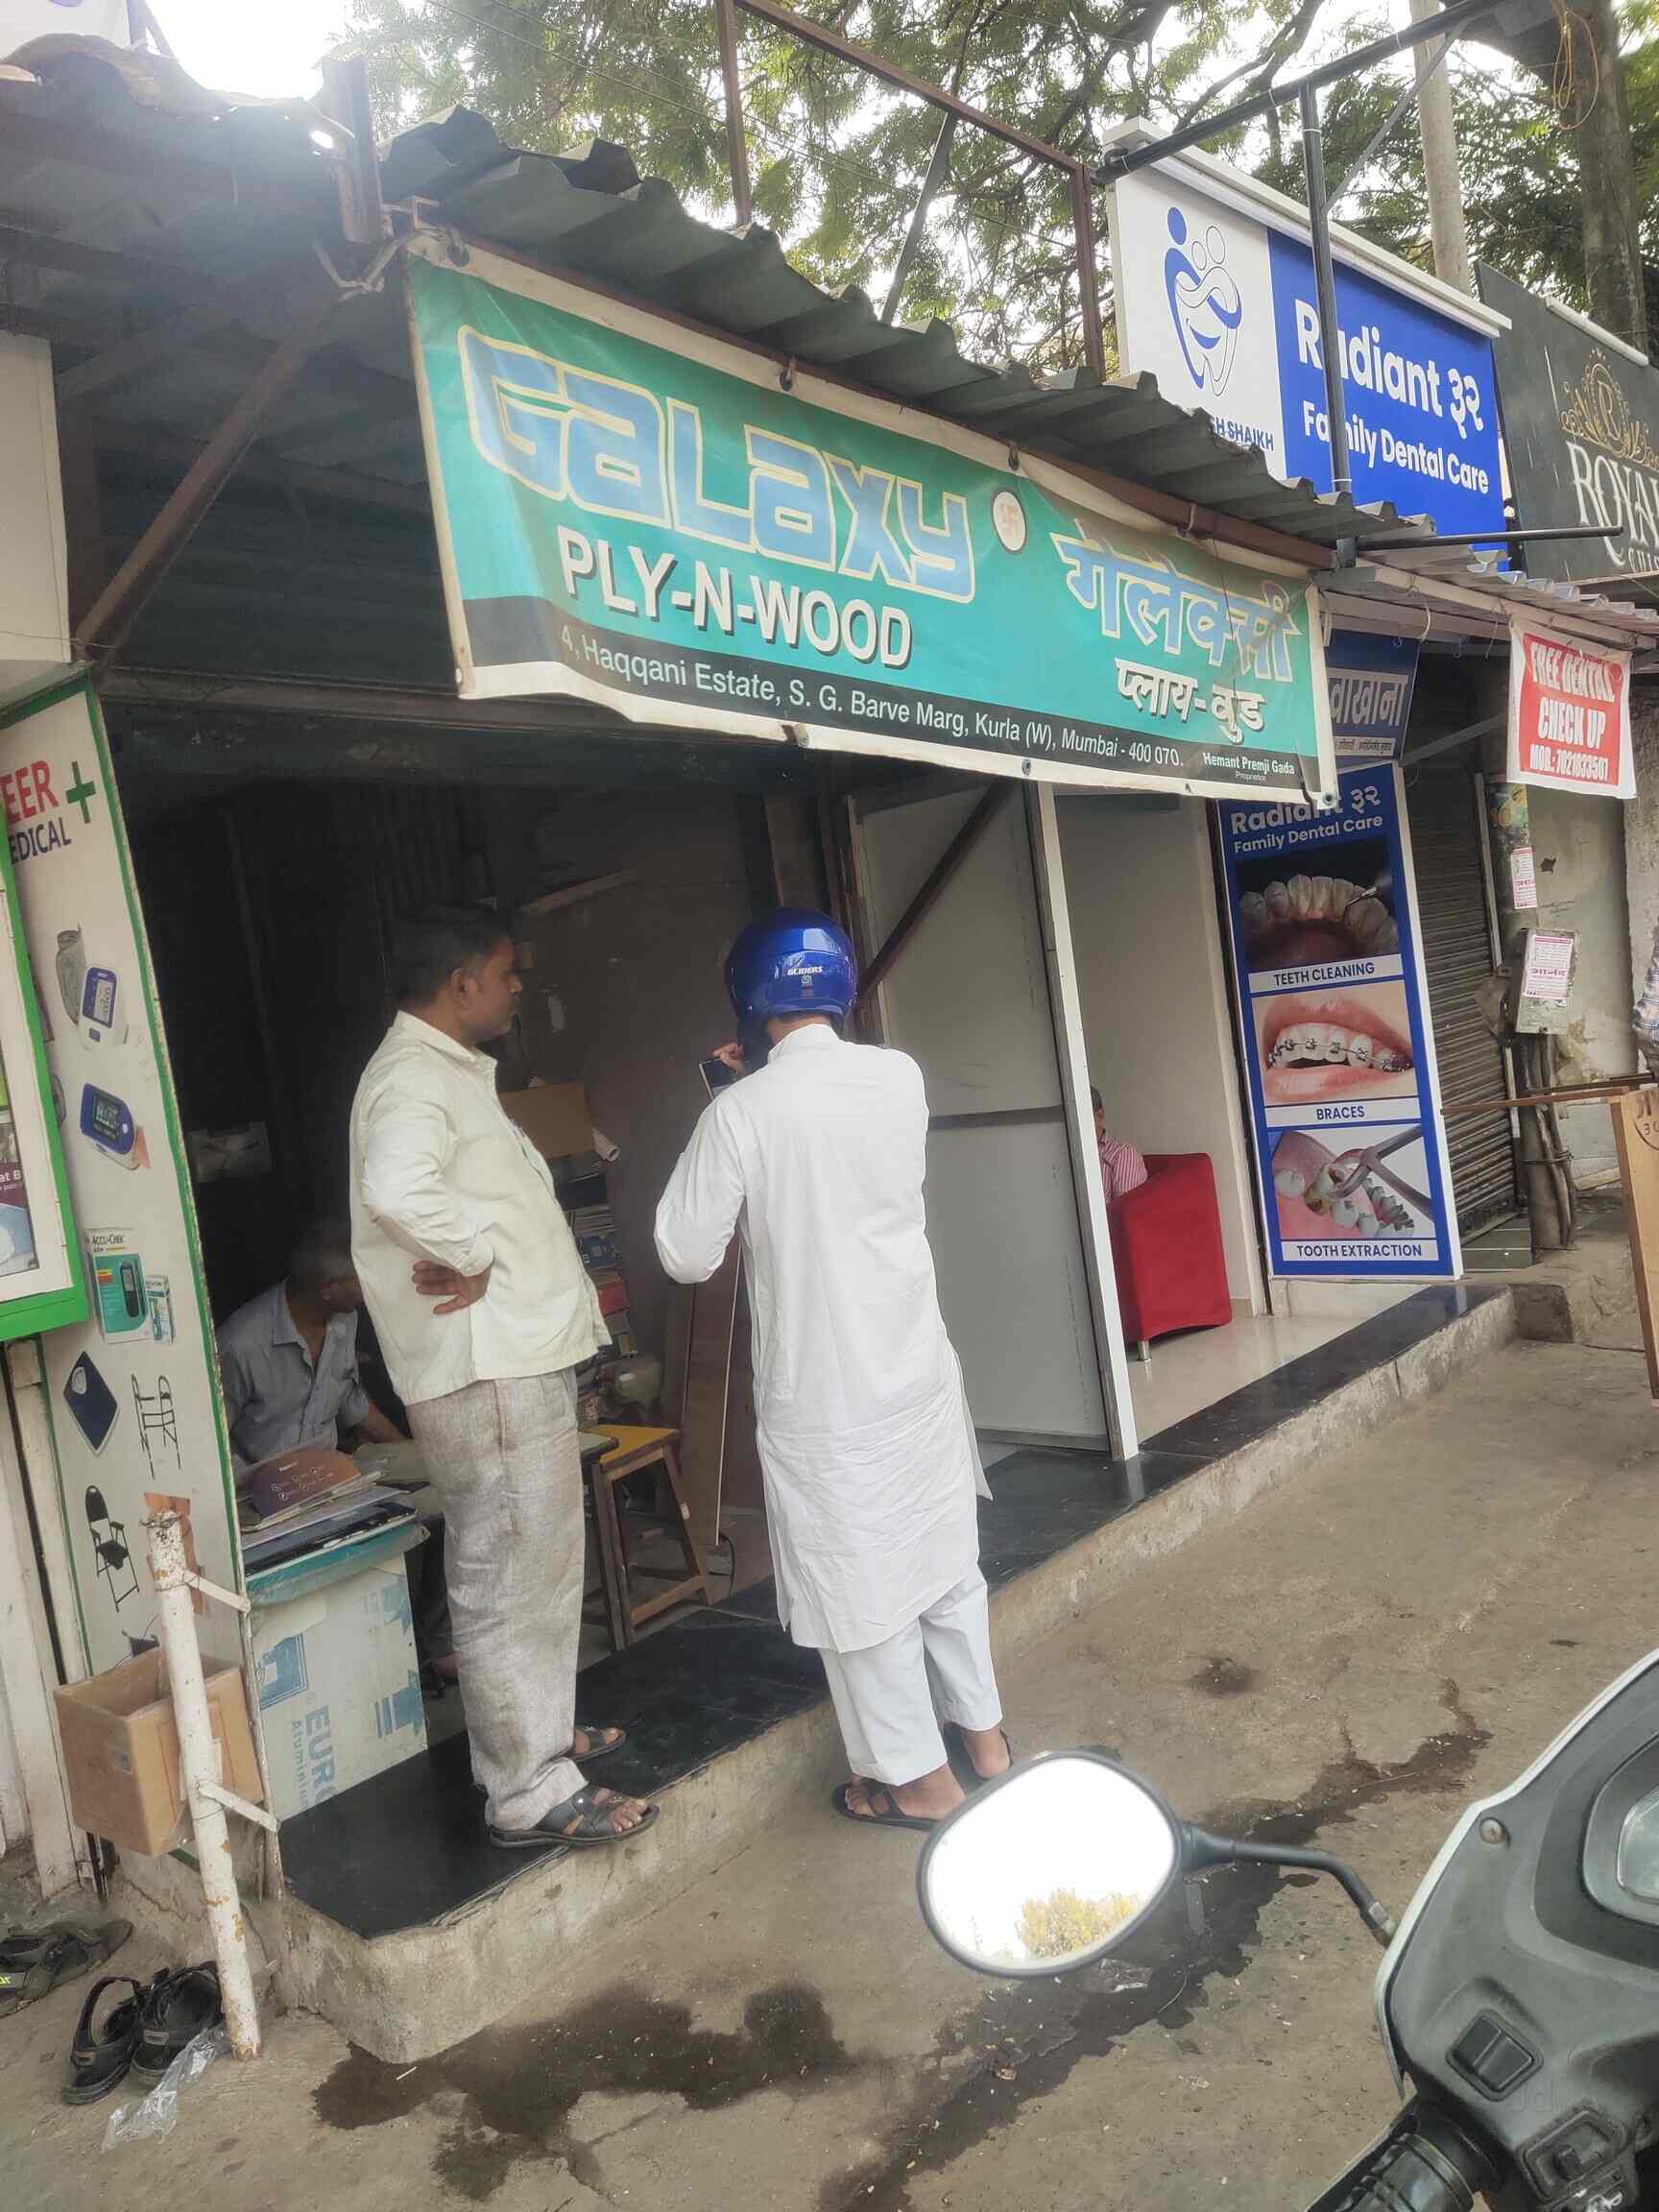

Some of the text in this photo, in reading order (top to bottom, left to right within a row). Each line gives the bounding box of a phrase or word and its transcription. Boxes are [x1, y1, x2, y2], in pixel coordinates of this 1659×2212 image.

[1295, 299, 1443, 418] Rdiant
[1227, 420, 1274, 451] SHAIKH
[1381, 427, 1444, 480] Dental
[1447, 452, 1489, 494] Care
[556, 524, 912, 669] PLY-N-WOOD
[1530, 641, 1562, 690] FREE
[561, 625, 580, 660] 4,
[582, 634, 686, 686] Haqqani
[694, 661, 781, 706] Estate,
[789, 679, 811, 707] S.
[819, 685, 843, 712] G.
[851, 690, 910, 722] Barve
[916, 701, 969, 737] Marg,
[975, 712, 1021, 741] Kurla
[1025, 721, 1056, 752] (W),
[1061, 728, 1118, 757] Mumbai
[1128, 741, 1152, 762] 400
[1154, 746, 1184, 767] 070.
[1537, 696, 1606, 750] CHECK UP
[1202, 752, 1295, 775] Hemant Premji Gada
[0, 760, 59, 824] EER
[9, 817, 72, 865] EDICAL
[1234, 815, 1383, 854] Family Dental Care
[1273, 962, 1375, 986] TEETH CLEANING
[1315, 1105, 1365, 1120] BRACES
[1296, 1244, 1422, 1257] TOOTH EXTRACTION
